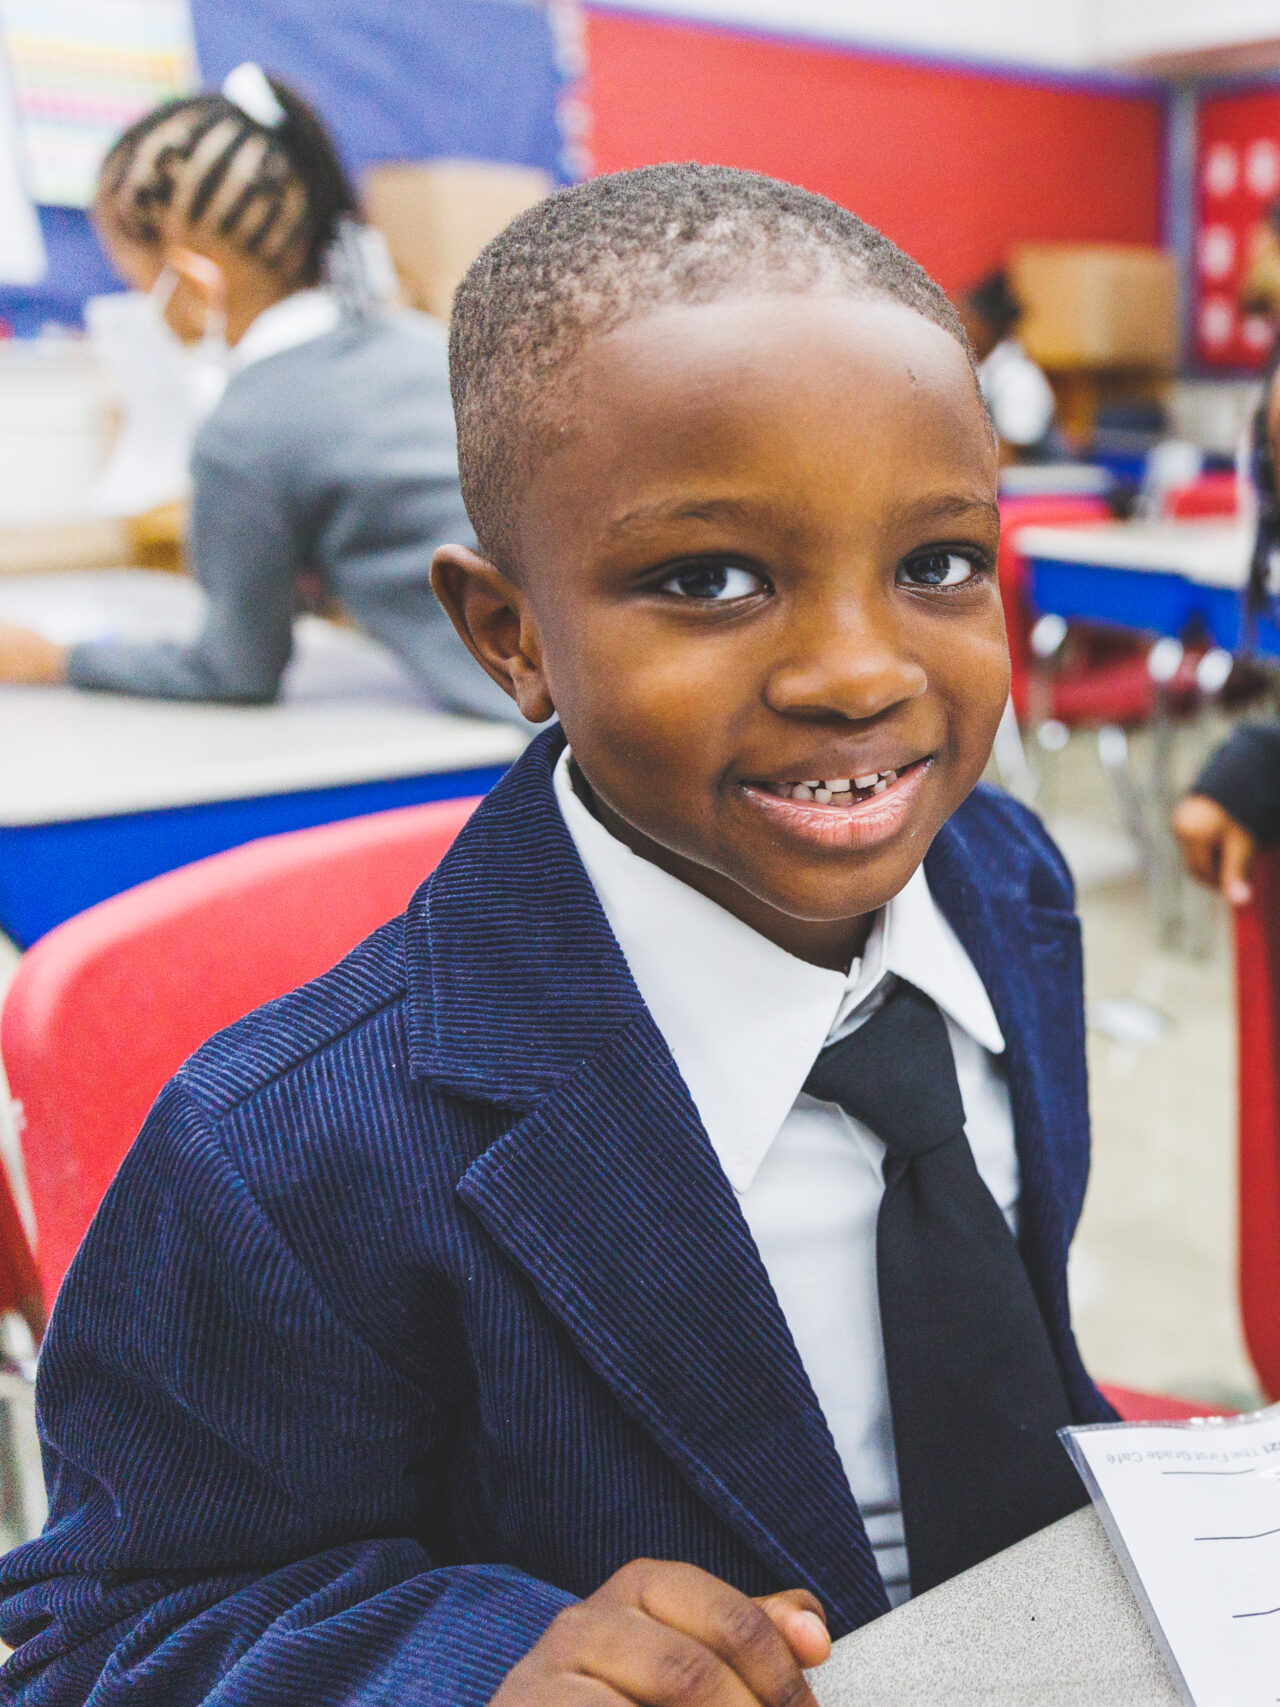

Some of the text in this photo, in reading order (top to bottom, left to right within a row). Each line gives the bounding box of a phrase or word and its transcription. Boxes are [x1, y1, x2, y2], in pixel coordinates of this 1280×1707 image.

[1106, 1452, 1143, 1464] Café
[1146, 1449, 1192, 1461] Grade
[1195, 1448, 1229, 1462] First
